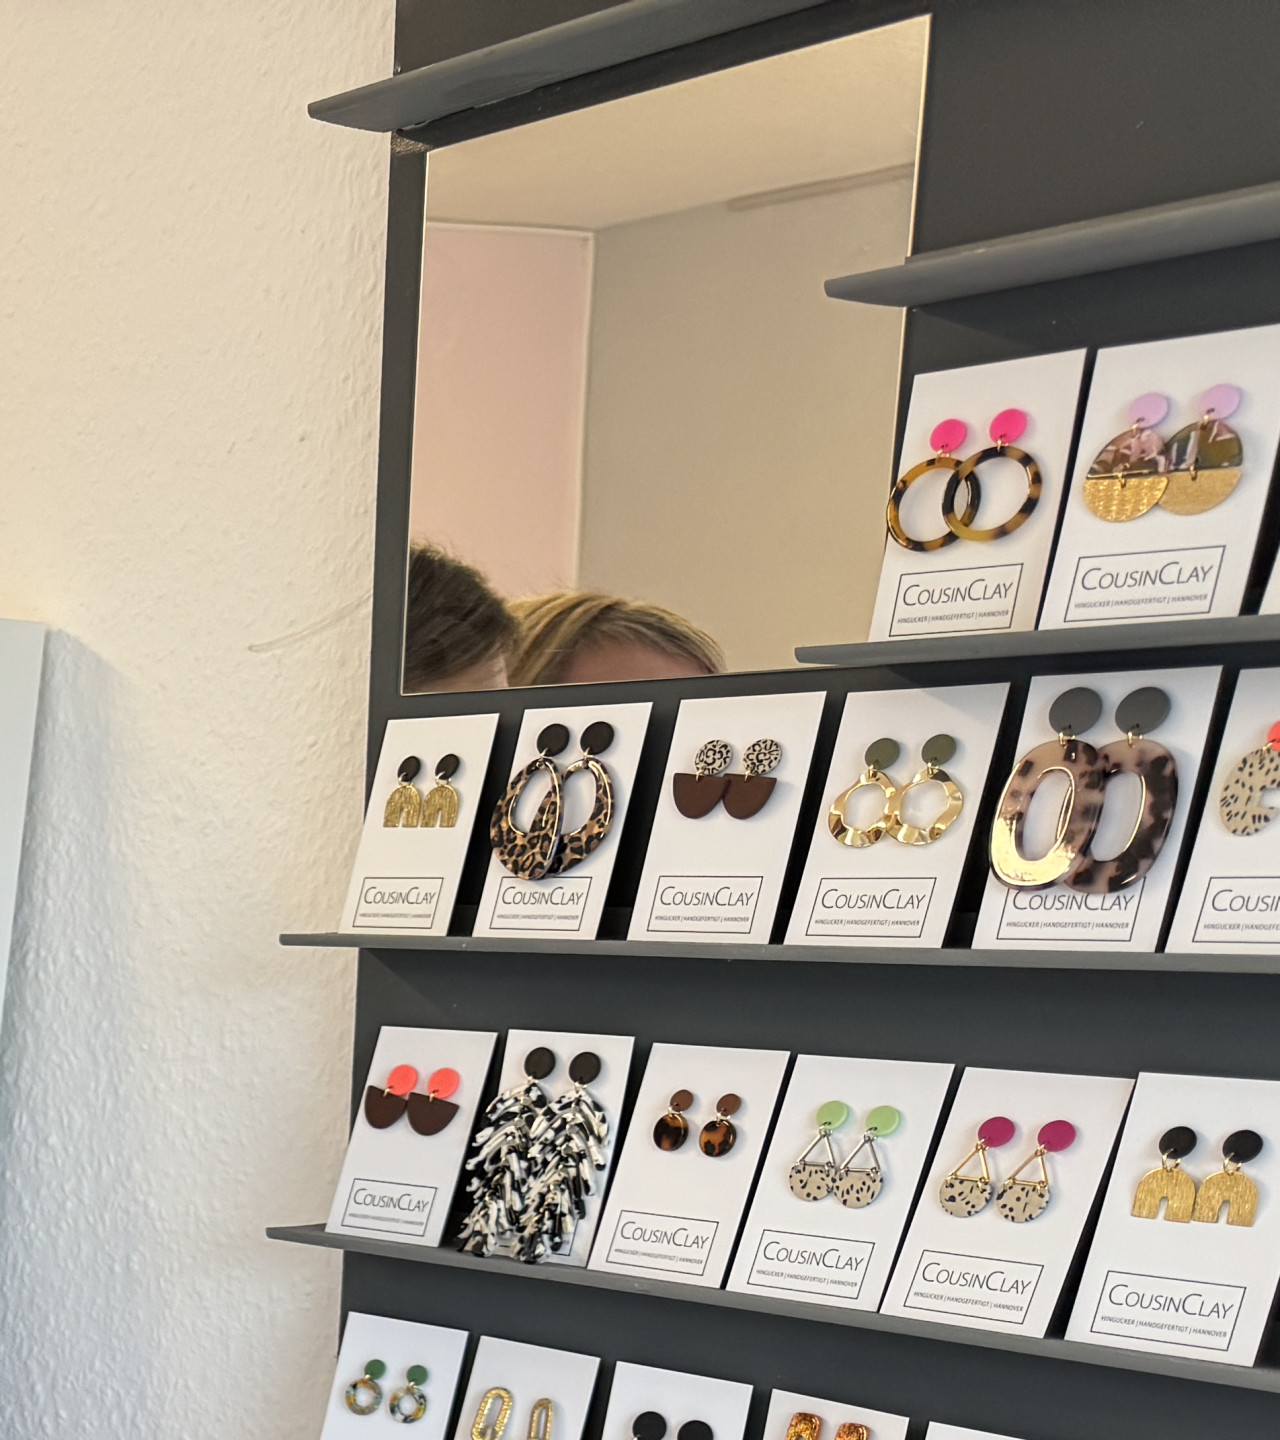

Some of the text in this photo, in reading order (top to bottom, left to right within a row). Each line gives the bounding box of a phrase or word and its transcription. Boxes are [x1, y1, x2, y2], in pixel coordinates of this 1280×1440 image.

[946, 1295, 990, 1307] HANDGEFERTIGT
[993, 1302, 1023, 1311] HANNOVER
[1138, 1320, 1188, 1332] HANDGEFERTIGT
[1192, 1327, 1227, 1337] HANNOVER
